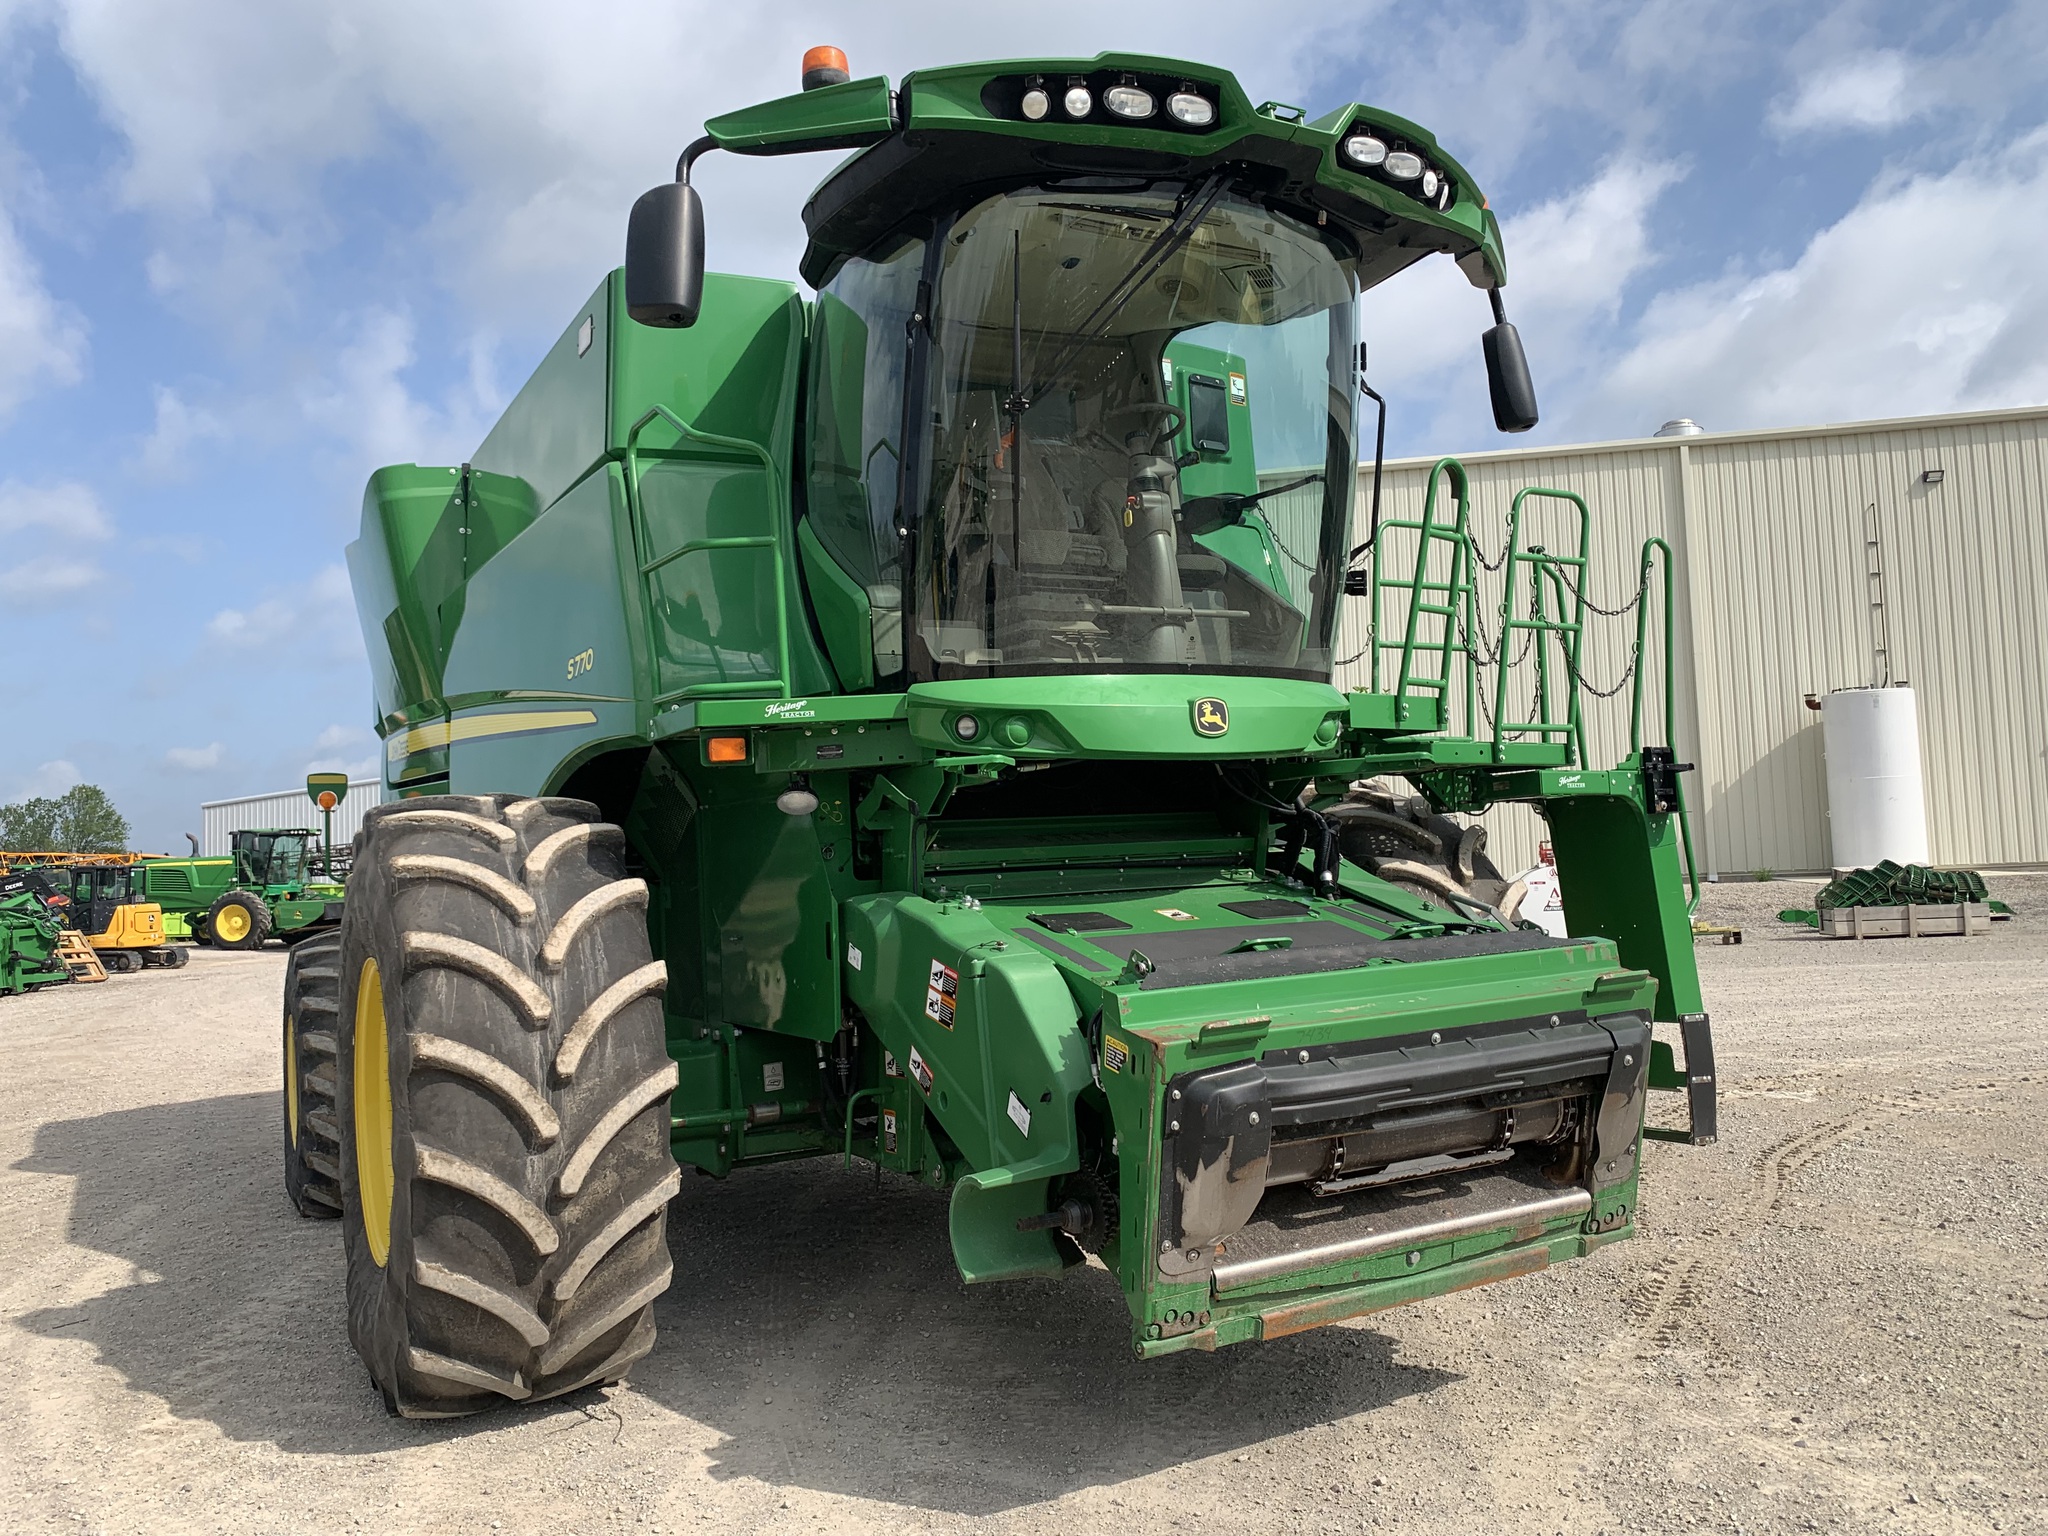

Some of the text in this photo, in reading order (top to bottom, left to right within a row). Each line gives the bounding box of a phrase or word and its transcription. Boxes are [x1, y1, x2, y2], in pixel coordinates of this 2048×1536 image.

[566, 647, 594, 680] S770
[764, 700, 807, 718] Heritage
[780, 710, 815, 718] TRACTOR
[1558, 774, 1581, 787] Heritage
[5, 881, 24, 891] DEERE
